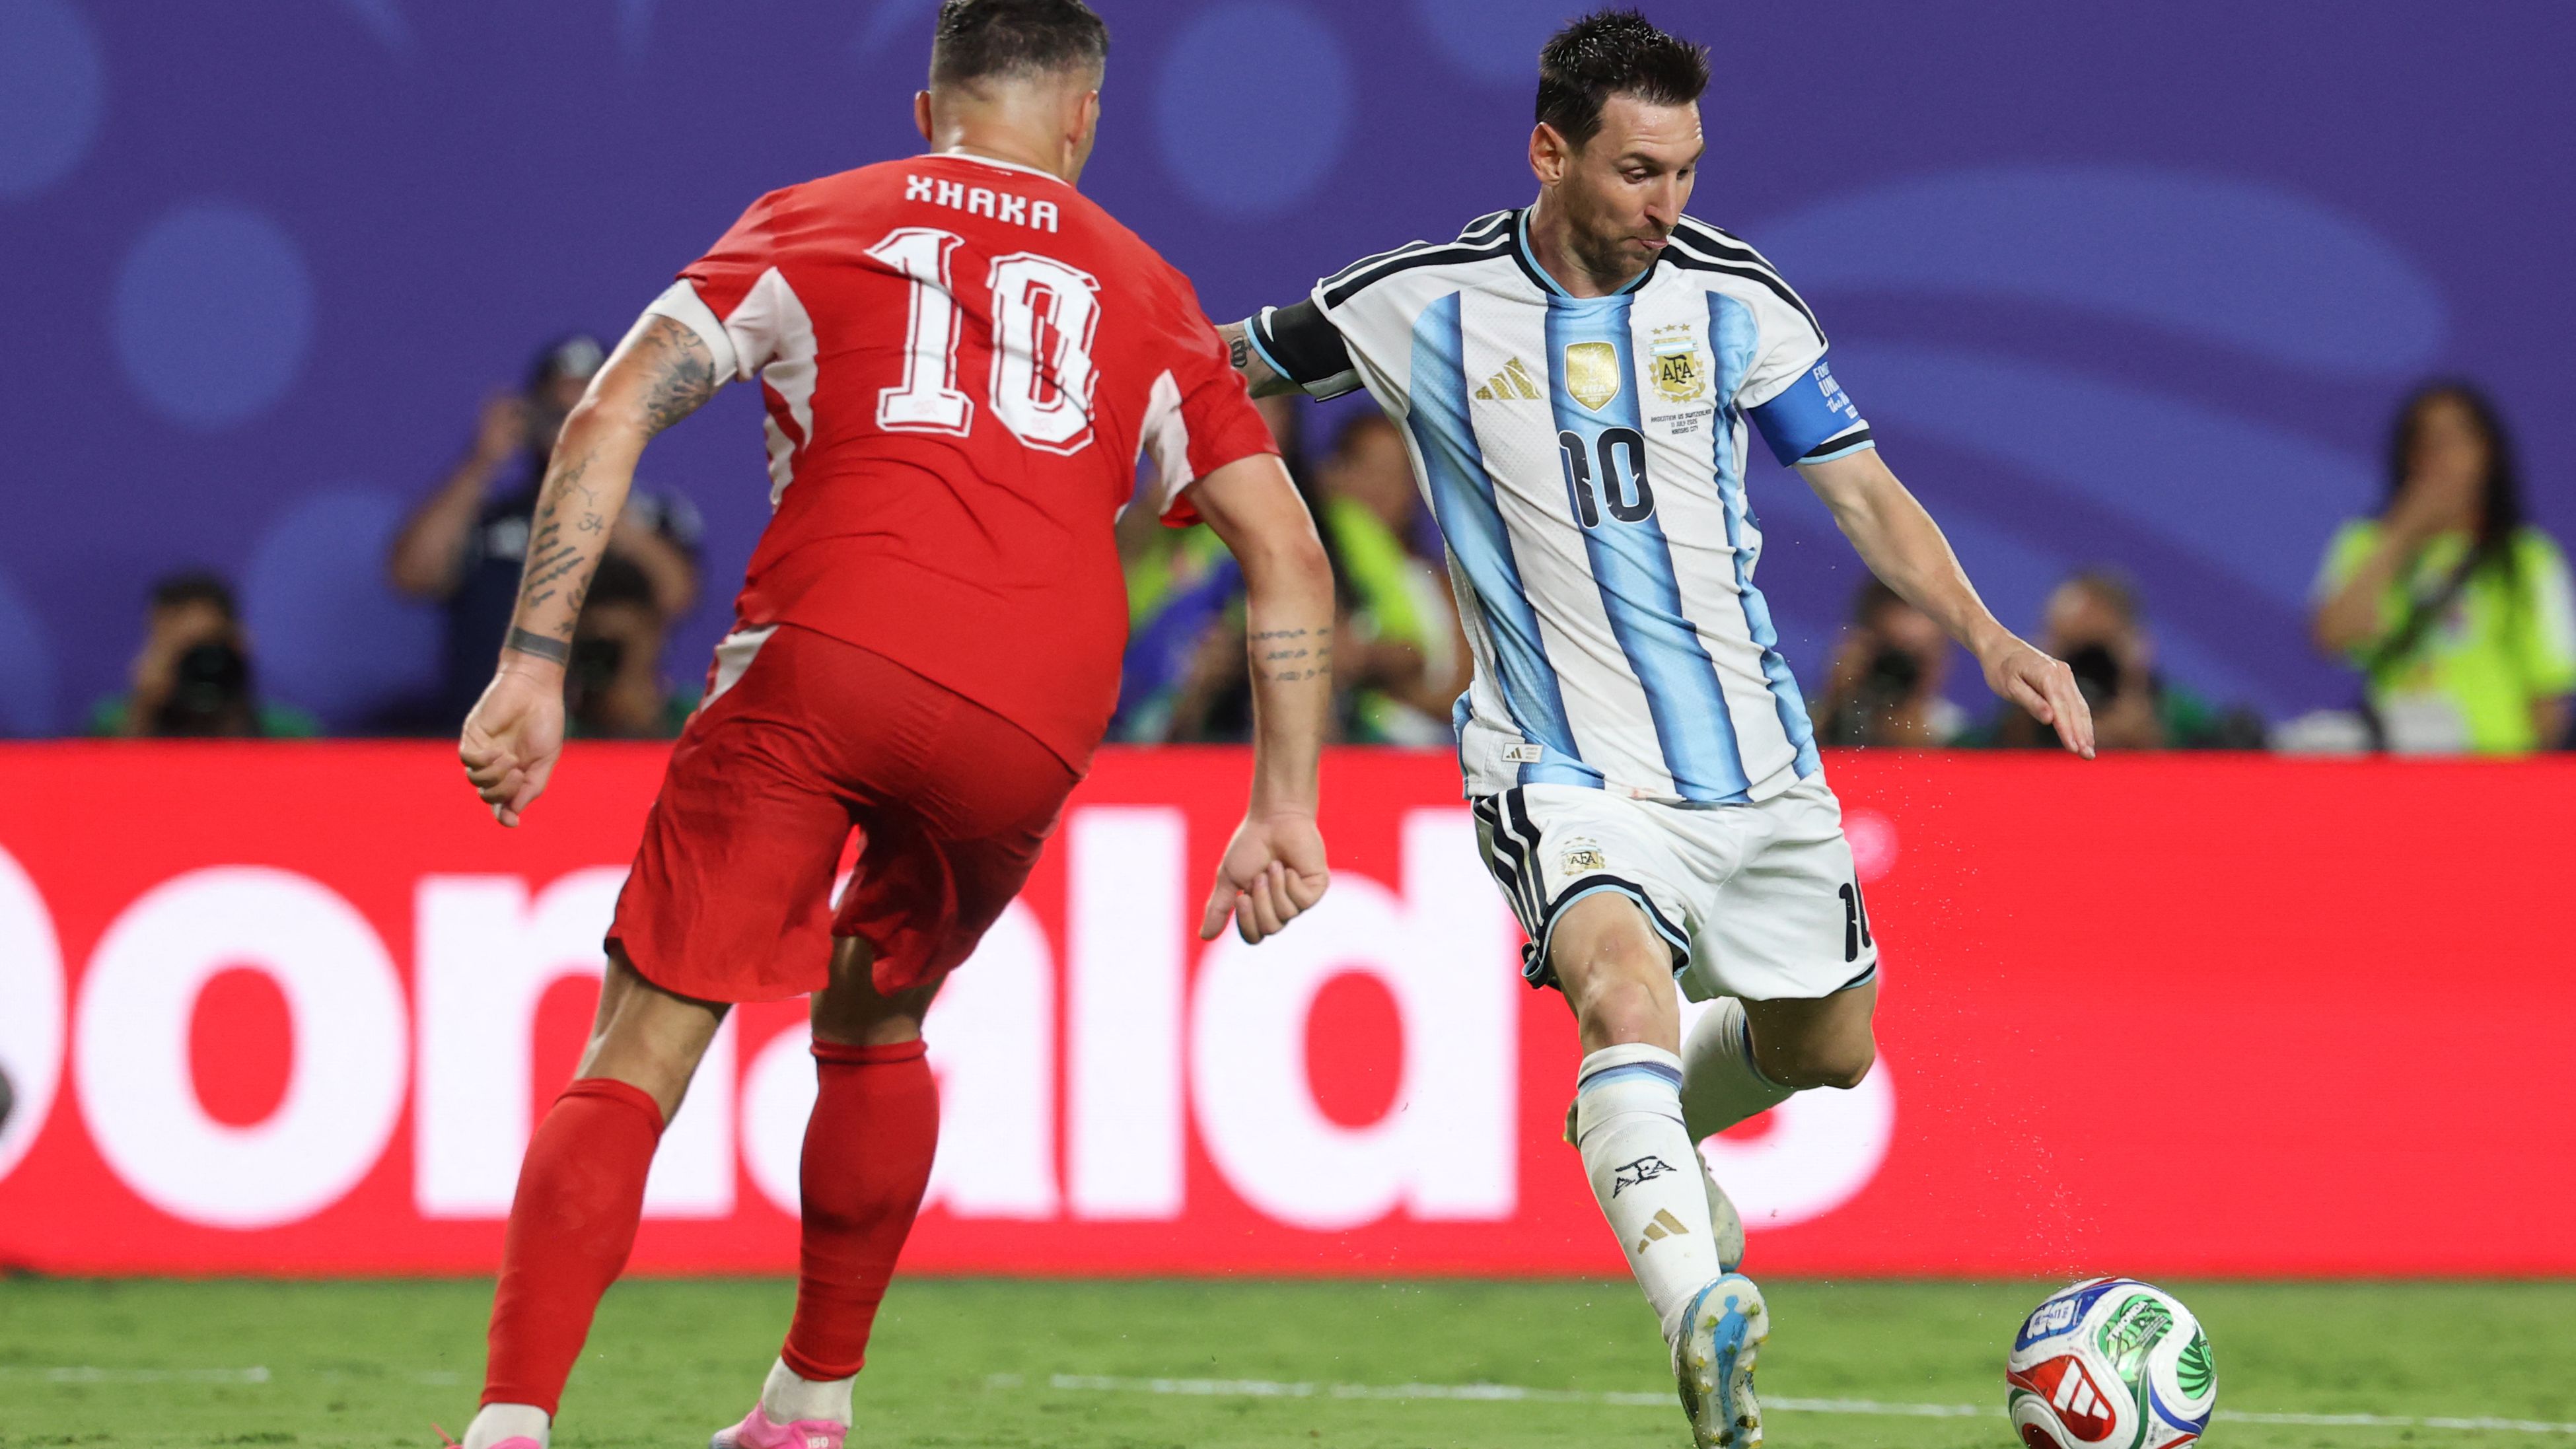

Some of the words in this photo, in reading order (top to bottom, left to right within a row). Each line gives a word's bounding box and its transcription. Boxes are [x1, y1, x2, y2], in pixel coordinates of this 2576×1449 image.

[905, 174, 1058, 233] XHAKA
[863, 227, 1102, 456] 10
[1662, 354, 1695, 384] AFA
[1558, 426, 1657, 529] 10
[1571, 851, 1598, 866] AFA
[1612, 1155, 1678, 1199] AFA
